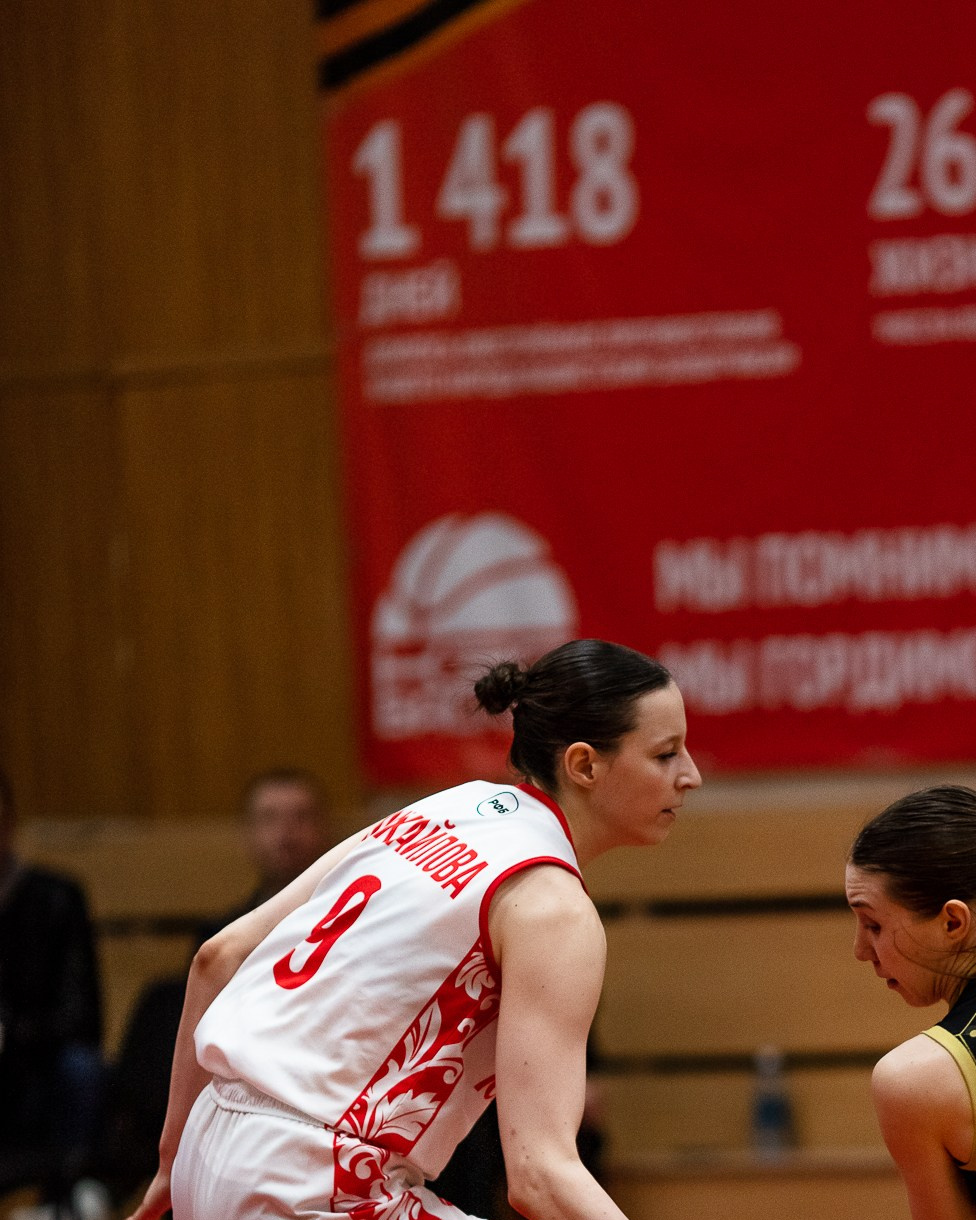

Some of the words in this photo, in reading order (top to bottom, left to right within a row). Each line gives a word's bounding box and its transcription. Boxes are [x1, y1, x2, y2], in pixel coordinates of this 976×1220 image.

[353, 118, 420, 260] 1
[437, 101, 639, 253] 418
[488, 799, 510, 814] РФБ
[273, 874, 382, 990] 9
